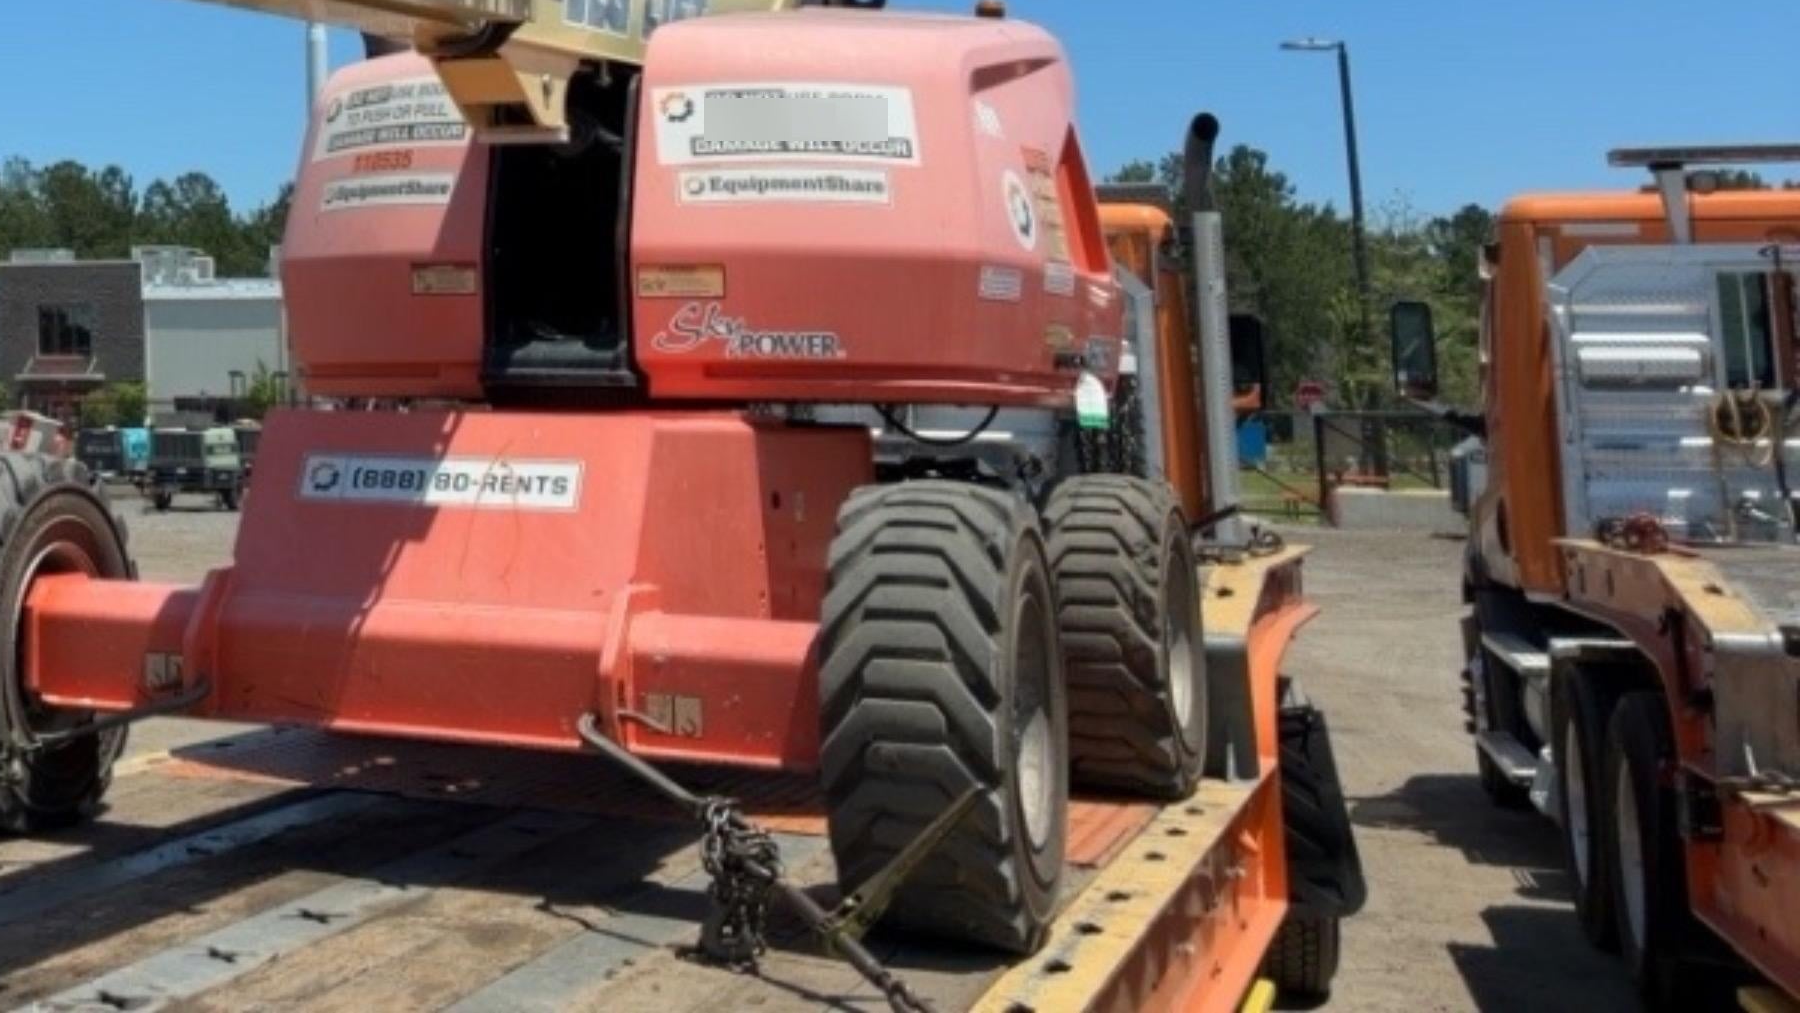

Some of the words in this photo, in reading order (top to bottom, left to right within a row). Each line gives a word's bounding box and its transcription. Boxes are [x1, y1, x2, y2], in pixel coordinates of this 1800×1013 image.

[709, 175, 886, 195] EquipmentShare
[650, 301, 745, 359] Sky
[738, 332, 838, 358] POWER
[352, 466, 425, 490] (888)
[434, 472, 568, 496] 80-RENTS
